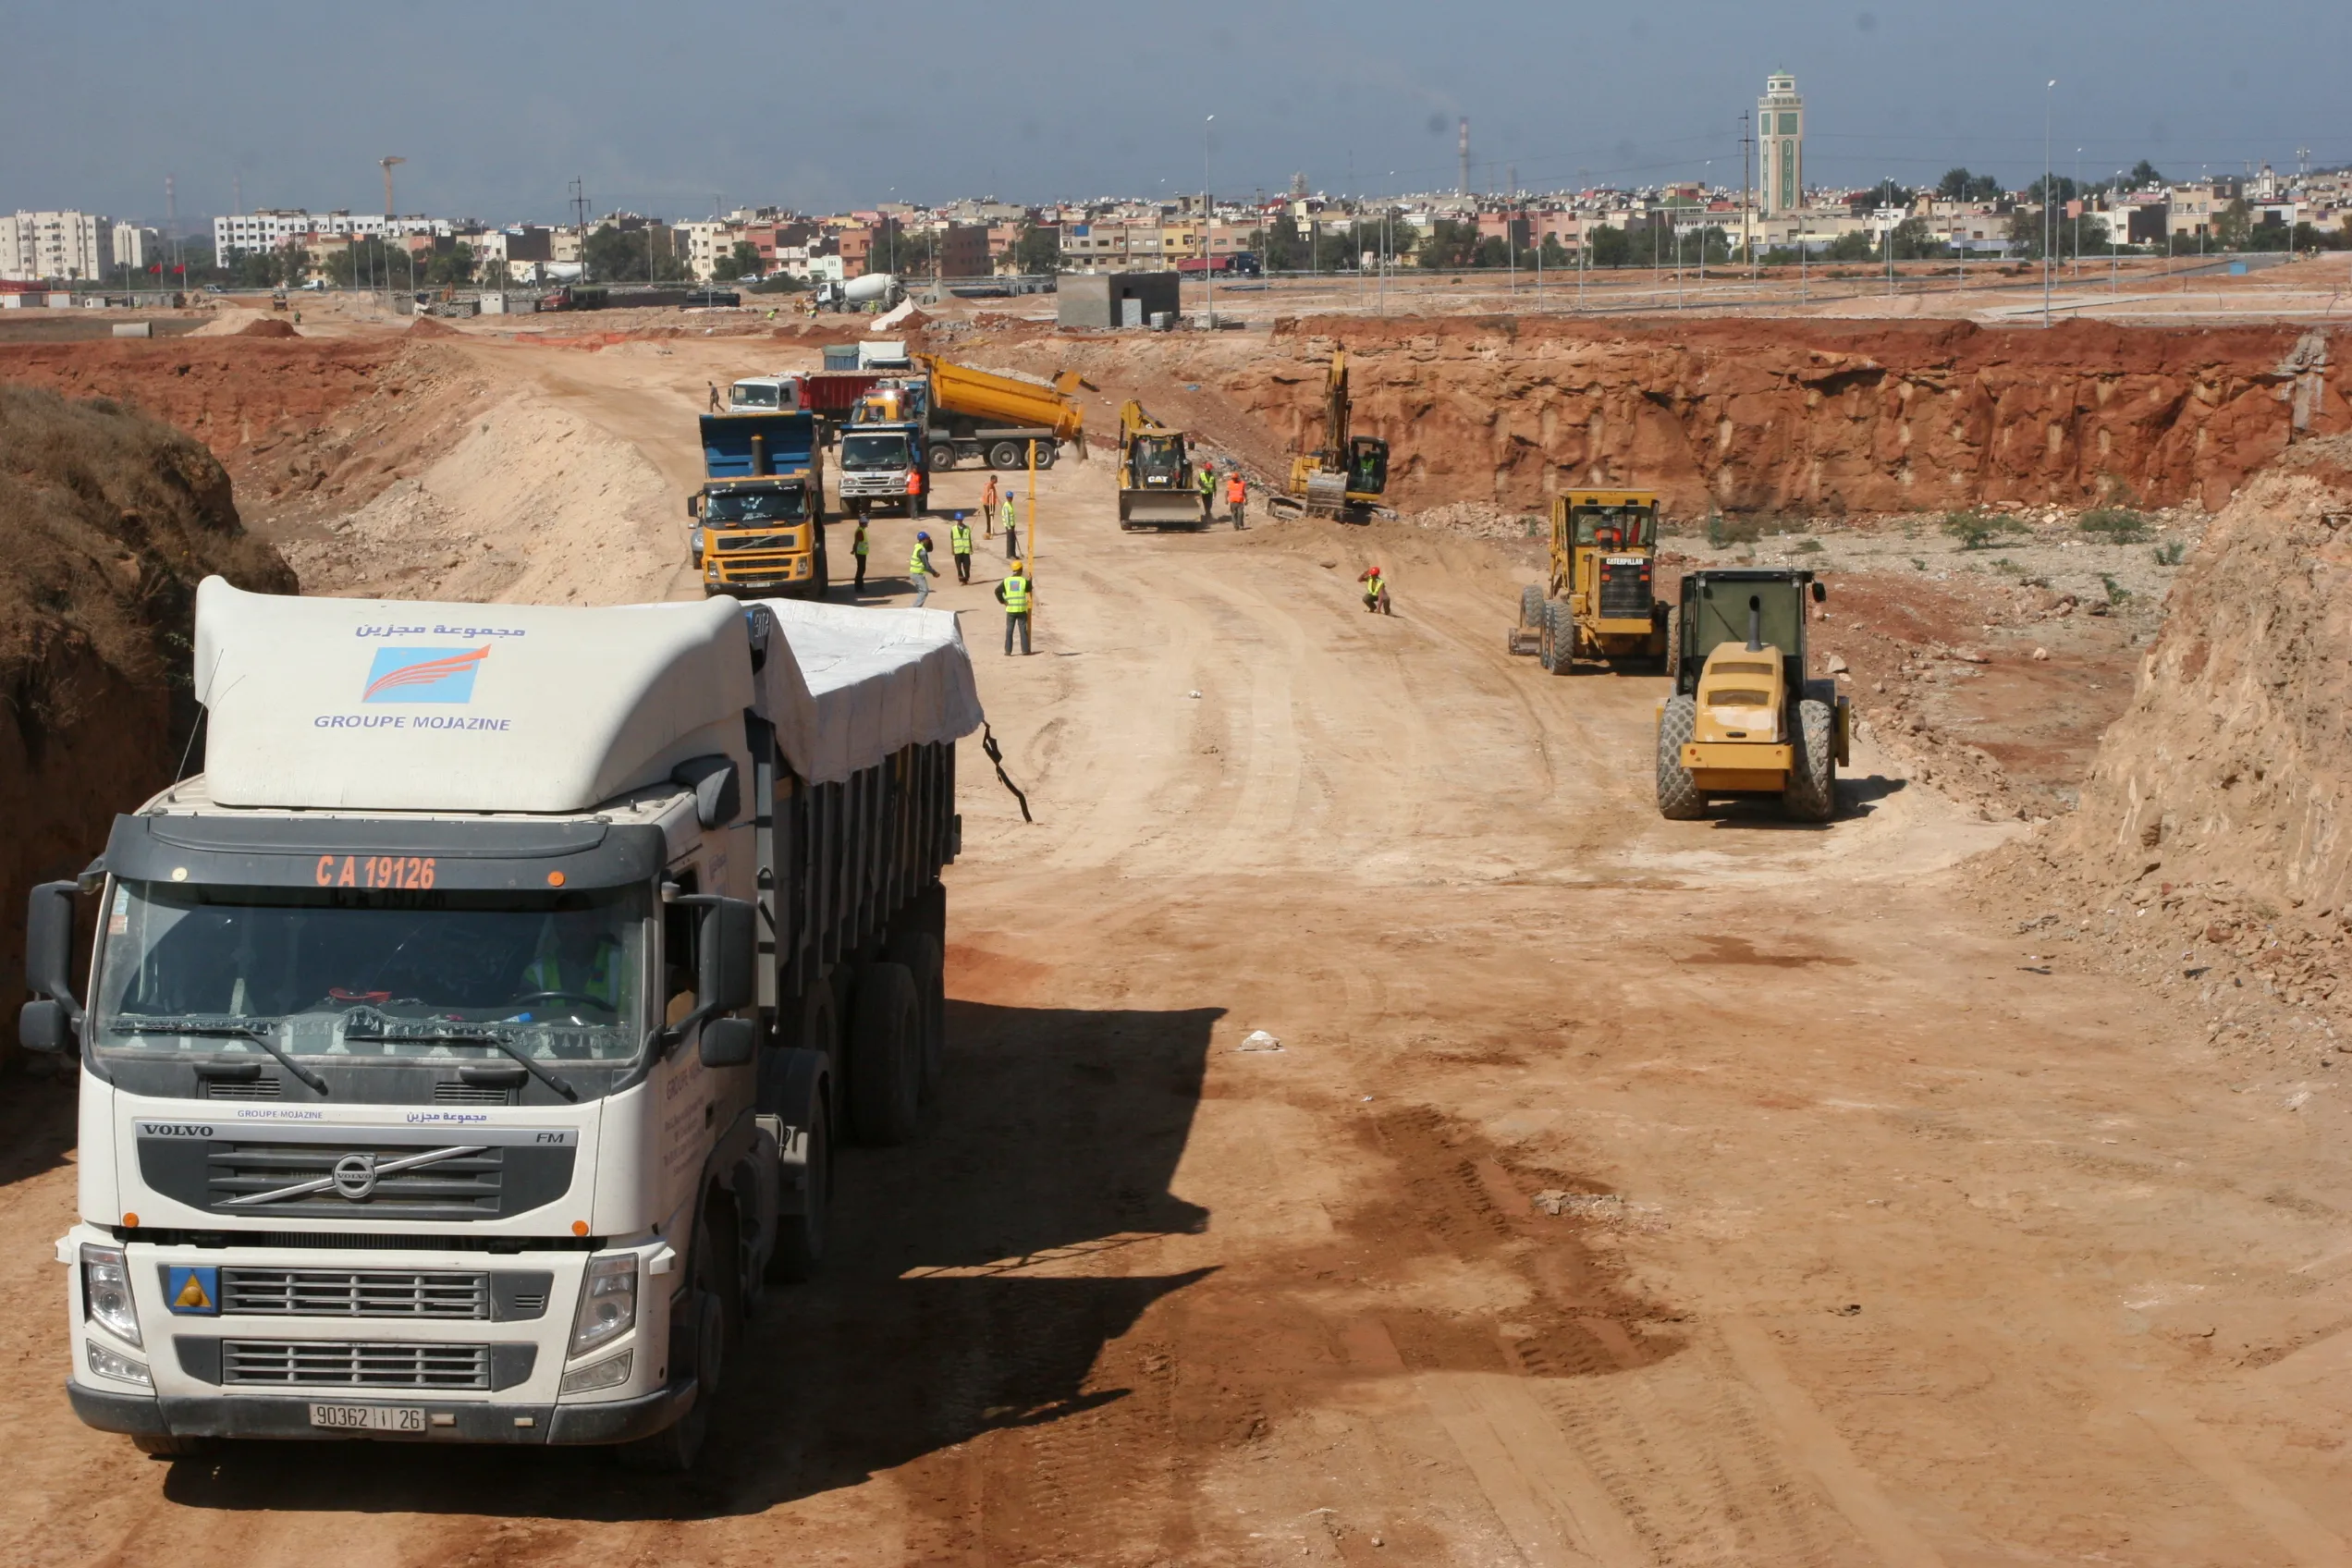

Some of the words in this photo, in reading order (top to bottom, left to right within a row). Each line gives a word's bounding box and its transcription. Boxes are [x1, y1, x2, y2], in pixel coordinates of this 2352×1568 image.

[1147, 475, 1169, 484] CAT
[355, 623, 426, 637] مجزين
[433, 624, 526, 639] مجموعة
[313, 715, 407, 729] GROUPE
[412, 716, 511, 731] MOJAZINE
[364, 856, 436, 889] 19126
[238, 1109, 277, 1118] GROUPE
[280, 1110, 323, 1119] MOJAZINE
[443, 1111, 487, 1123] مجموعة
[142, 1123, 214, 1137] VOLVO
[536, 1133, 565, 1144] FM
[316, 1406, 367, 1427] 90362
[399, 1409, 420, 1429] 26
